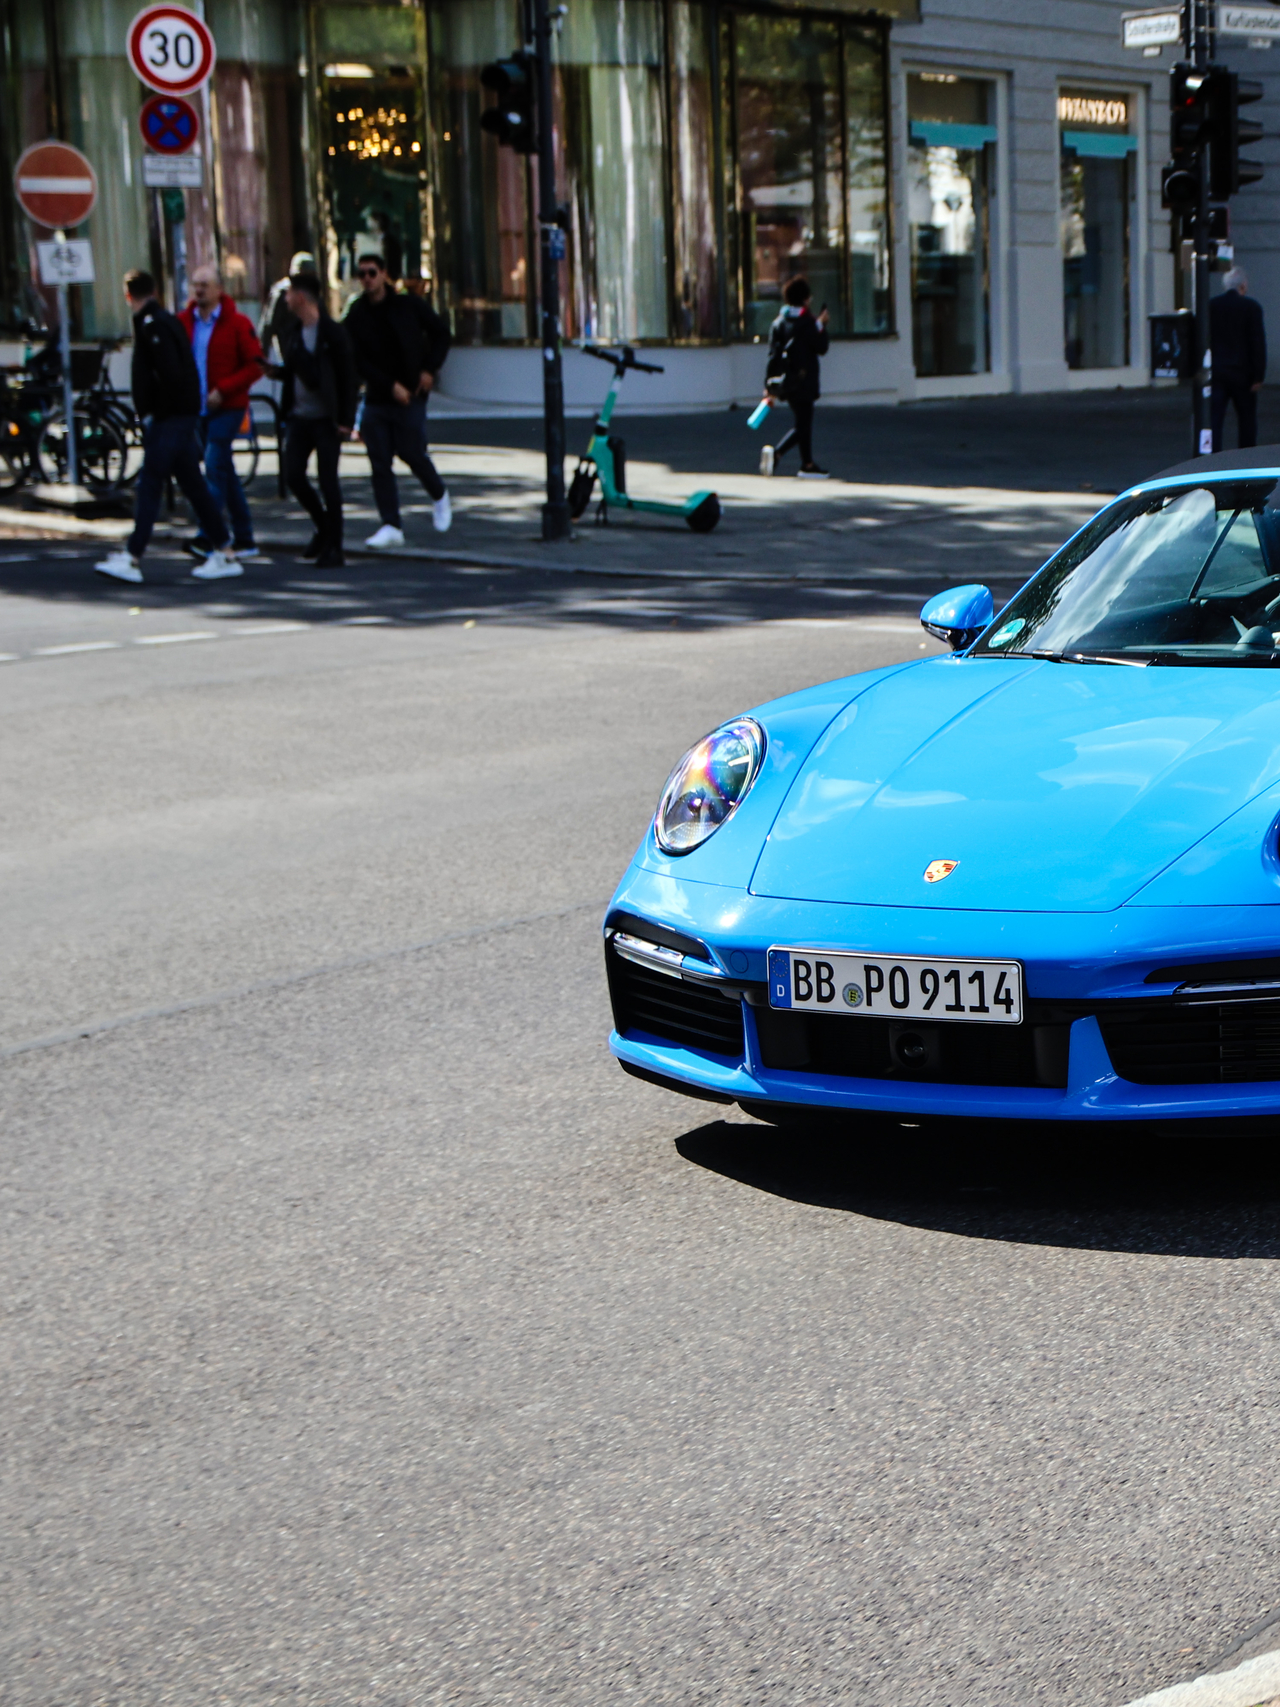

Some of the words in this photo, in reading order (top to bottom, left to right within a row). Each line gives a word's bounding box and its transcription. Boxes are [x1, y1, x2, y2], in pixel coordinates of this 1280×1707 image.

[149, 30, 195, 69] 30
[776, 984, 785, 997] D
[793, 959, 836, 1004] BB
[863, 964, 911, 1009] PO
[919, 968, 1014, 1014] 9114
